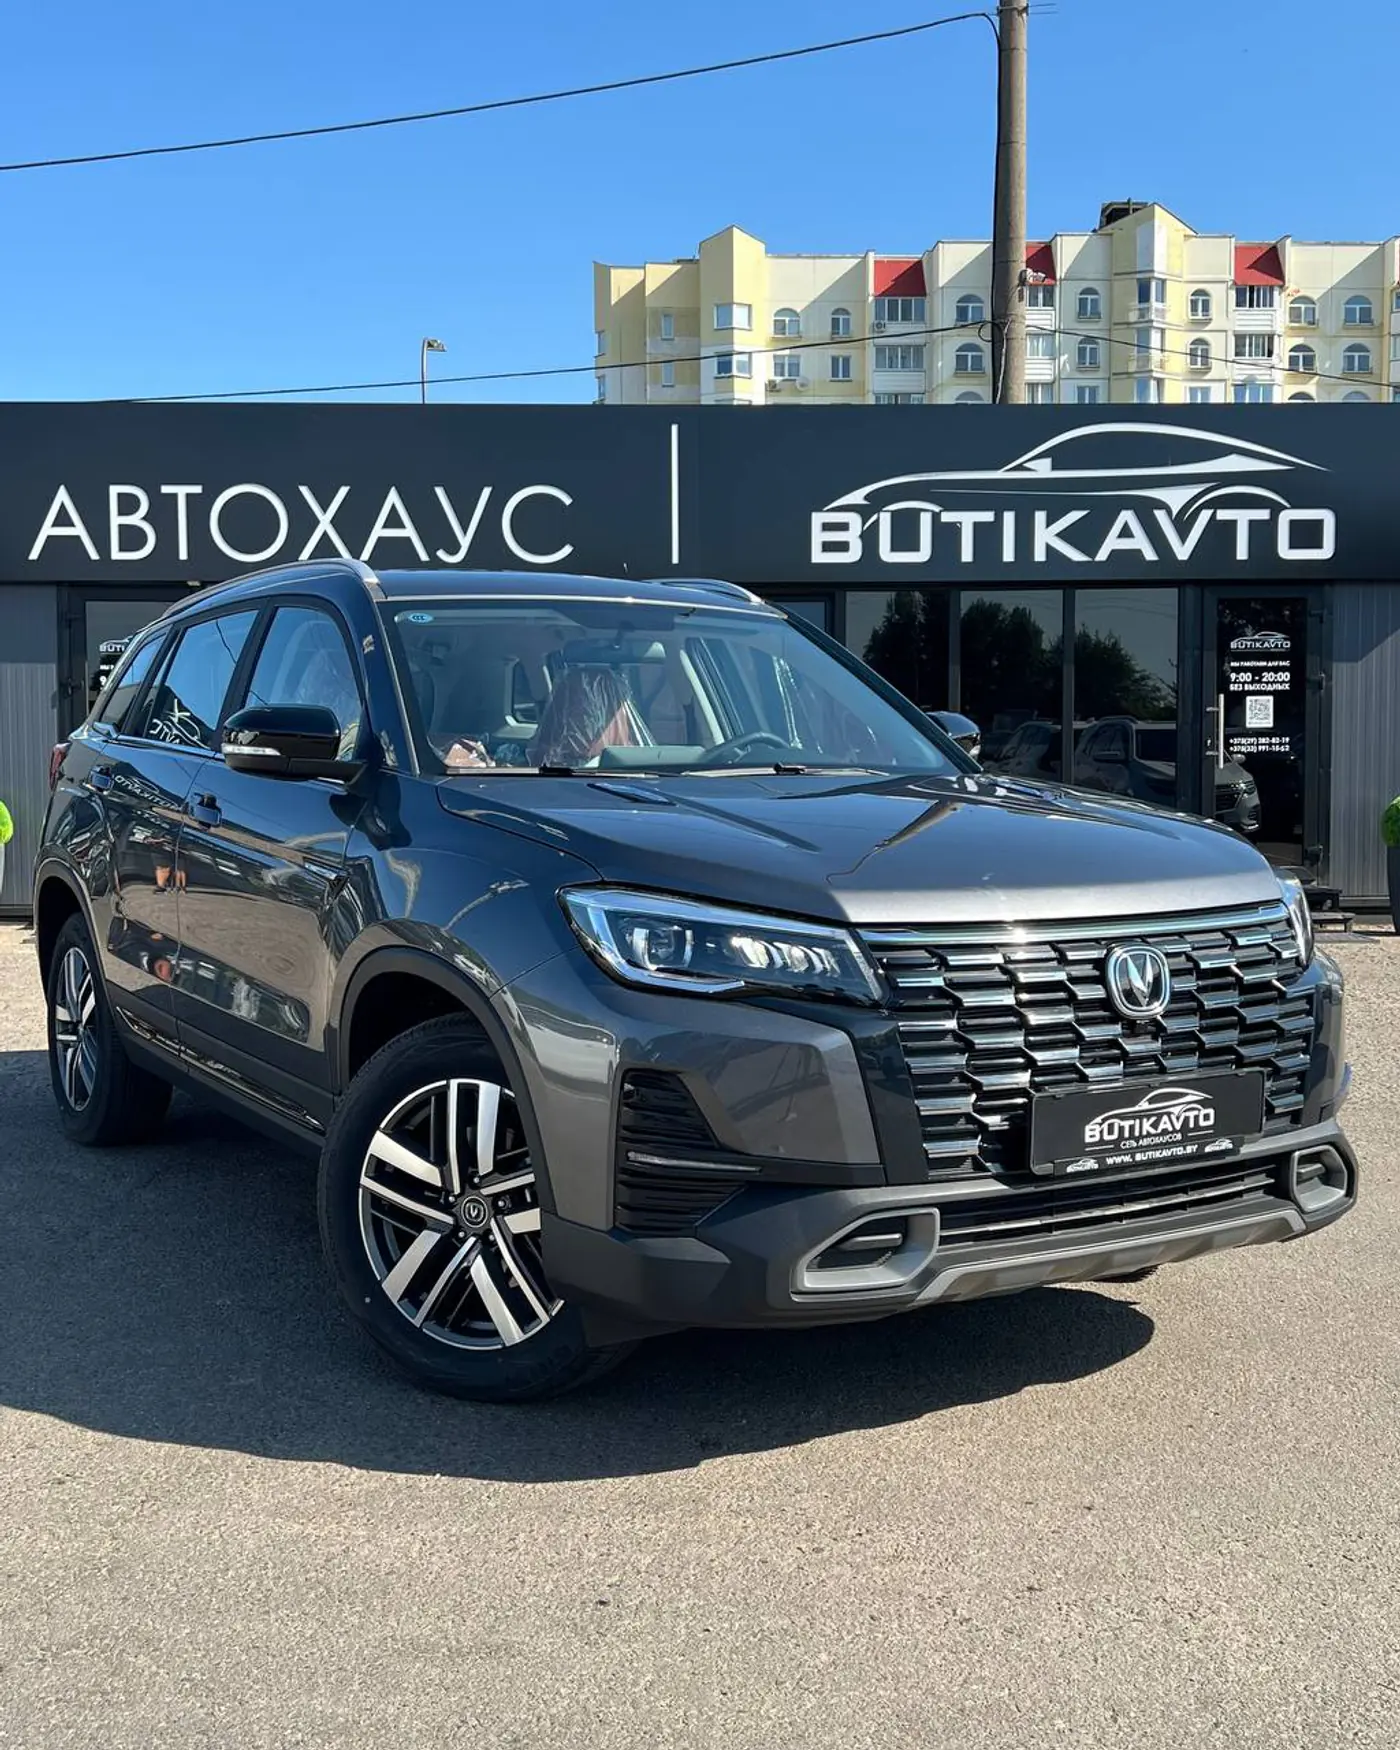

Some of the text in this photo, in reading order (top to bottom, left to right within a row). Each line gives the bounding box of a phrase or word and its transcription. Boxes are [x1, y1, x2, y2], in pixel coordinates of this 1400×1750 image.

[28, 483, 574, 564] АВТОХАУС
[810, 507, 1337, 564] BUTIKAVTO
[1230, 640, 1291, 649] BUTIKAVTO
[1230, 672, 1252, 682] 9:00
[1261, 671, 1291, 682] 20:00
[1084, 1107, 1216, 1143] BUTIKAVTO
